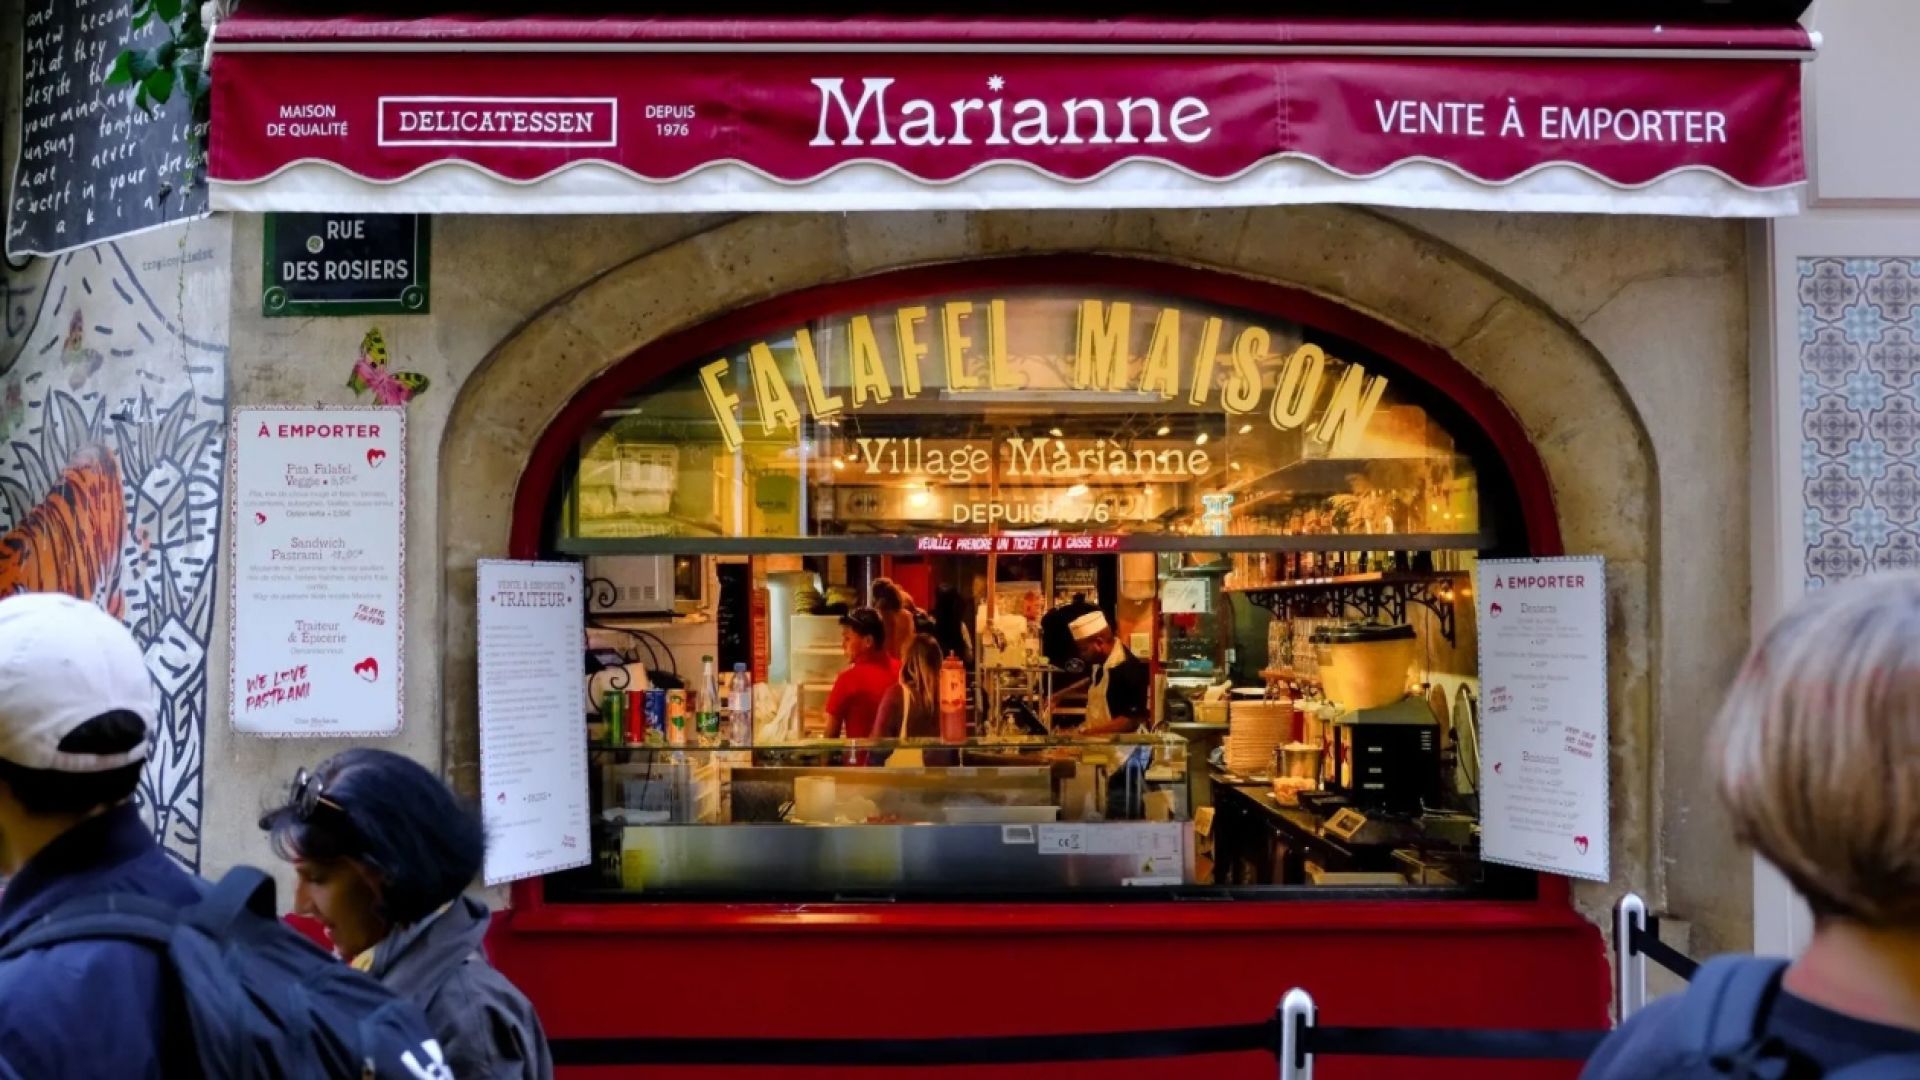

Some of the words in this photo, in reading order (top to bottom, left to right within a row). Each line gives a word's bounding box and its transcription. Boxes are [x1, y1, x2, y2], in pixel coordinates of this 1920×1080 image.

[26, 45, 63, 80] what
[74, 38, 107, 63] they
[25, 72, 71, 107] despite
[25, 113, 56, 143] your
[61, 88, 99, 122] mind
[280, 104, 337, 118] MAISON
[645, 105, 696, 119] DEPUIS
[808, 74, 1212, 146] Marianne
[1375, 99, 1485, 136] VENTE
[1500, 97, 1525, 137] À
[1541, 106, 1727, 143] EMPORTER
[266, 124, 285, 136] DE
[289, 121, 348, 137] QUALITÉ
[398, 111, 595, 133] DELICATESSEN
[656, 124, 690, 137] 1976
[24, 132, 74, 159] unsung
[20, 165, 55, 188] have
[91, 142, 136, 169] never
[15, 180, 71, 214] except
[82, 180, 95, 199] in
[110, 167, 146, 200] your
[327, 220, 366, 239] RUE
[283, 260, 320, 281] DES
[325, 259, 409, 280] ROSIERS
[698, 298, 1028, 453] FALAFEL
[1073, 299, 1389, 456] MAISON
[258, 421, 270, 438] À
[278, 424, 381, 438] EMPORTER
[286, 463, 310, 475] Pita
[314, 463, 352, 475] Falafel
[856, 437, 990, 483] Village
[1006, 436, 1211, 476] Marianne
[285, 475, 320, 488] Veggie
[953, 503, 1045, 524] DEPUIS
[290, 537, 346, 549] Sandwich
[996, 536, 1009, 551] UN
[1013, 536, 1040, 551] TICKET
[1052, 536, 1063, 550] LA
[1066, 536, 1094, 549] CAISSE
[271, 549, 323, 561] Pastrami
[1508, 575, 1585, 589] EMPORTER
[497, 591, 566, 607] TRAITEUR
[294, 619, 341, 632] Traiteur
[246, 674, 268, 693] WE
[273, 663, 308, 687] LOVE
